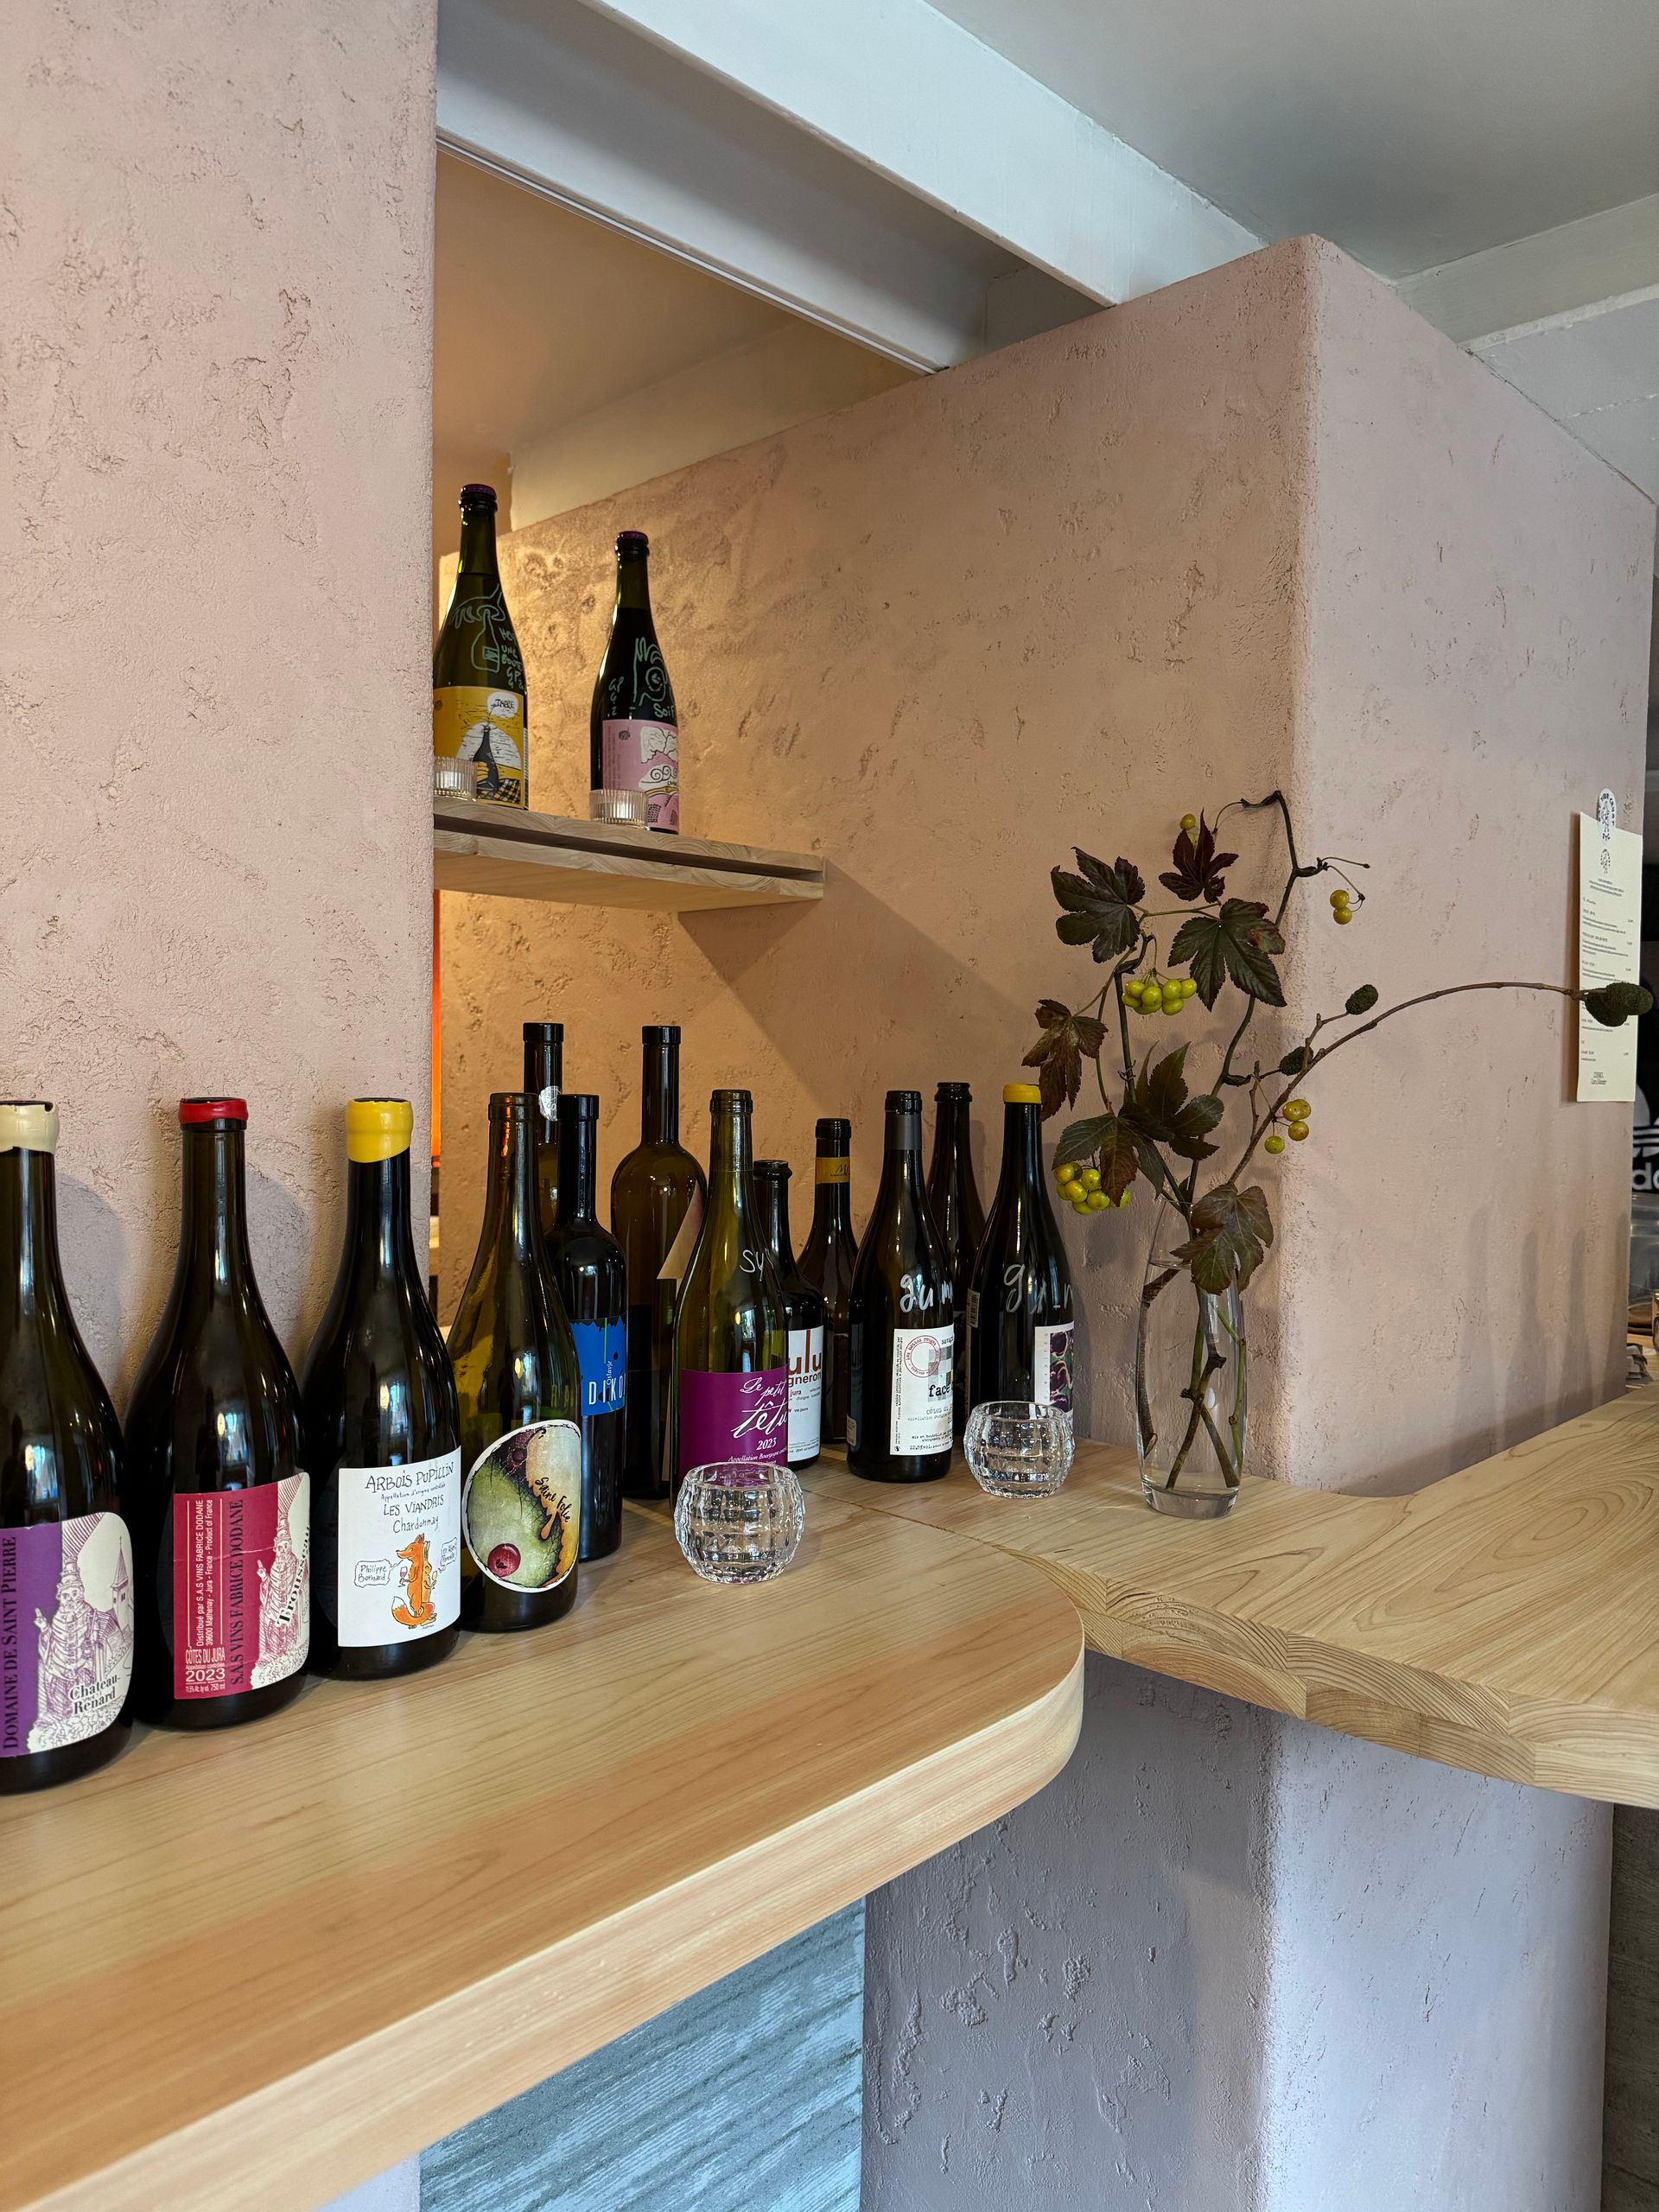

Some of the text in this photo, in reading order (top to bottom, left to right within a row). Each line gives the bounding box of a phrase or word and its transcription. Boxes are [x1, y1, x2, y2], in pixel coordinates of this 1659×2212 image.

[740, 1376, 763, 1394] Le
[755, 1437, 778, 1451] 2023
[384, 1504, 400, 1516] LES
[229, 1499, 243, 1558] DODANE
[393, 1516, 439, 1534] Chardonnay
[358, 1573, 385, 1582] Bornard
[360, 1564, 387, 1573] Philippe
[229, 1560, 243, 1618] FABRICE
[2, 1536, 19, 1750] DOMAINE DE SAINT PIERRE
[230, 1620, 243, 1652] VINS
[203, 1648, 211, 1663] DU
[212, 1647, 226, 1662] JURA
[185, 1668, 226, 1682] 2023
[73, 1687, 116, 1715] Renard
